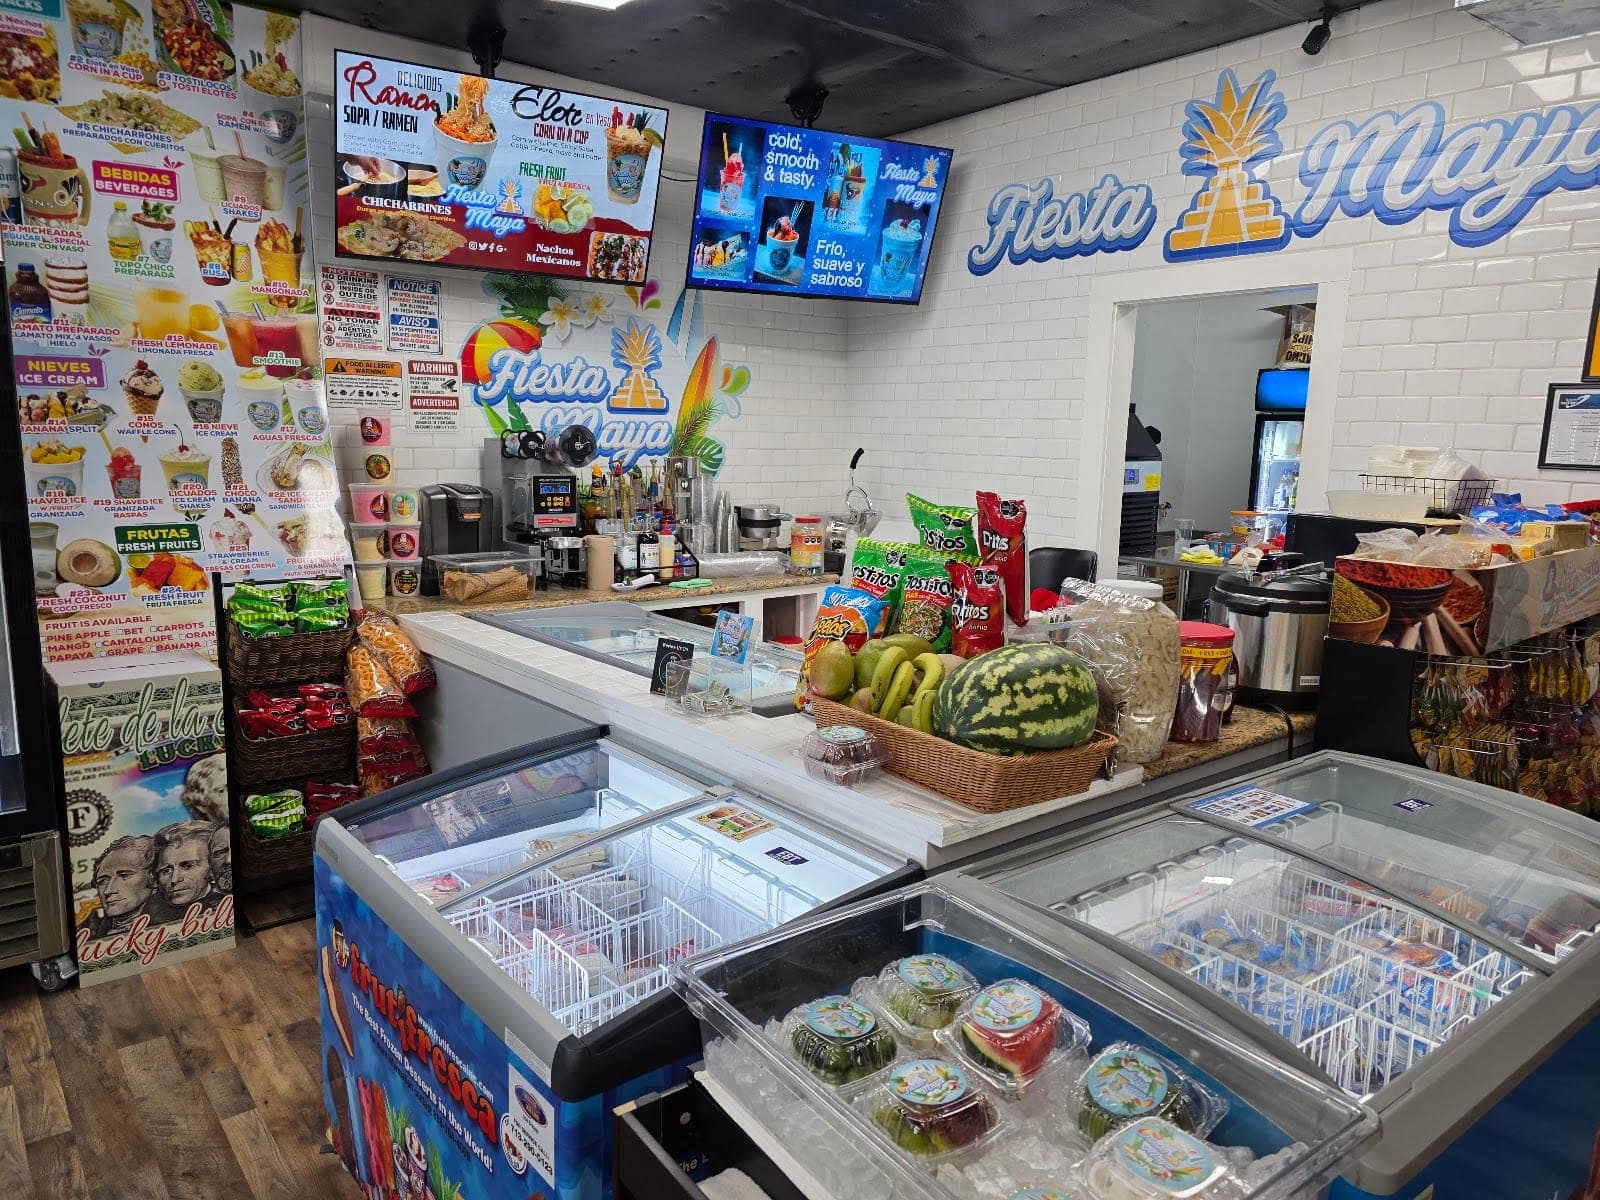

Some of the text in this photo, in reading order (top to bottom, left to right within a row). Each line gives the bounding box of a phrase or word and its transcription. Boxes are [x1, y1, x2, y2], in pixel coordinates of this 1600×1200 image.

[67, 62, 143, 81] CORN IN A CUP
[173, 75, 232, 92] TOSTILOCOS
[397, 70, 443, 93] DELICIOUS
[201, 86, 237, 100] ELOTES
[217, 119, 251, 133] RAMEN
[343, 105, 419, 134] SOPA / RAMEN
[585, 113, 594, 125] en
[596, 114, 612, 128] Vaso
[62, 127, 186, 153] PREPARADOS CON CUERITOS
[92, 124, 172, 143] CHICHARRONES
[533, 122, 590, 145] CORN IN A CUP
[768, 132, 803, 153] cold,
[765, 151, 820, 172] smooth
[101, 166, 171, 186] BEBIDAS
[519, 161, 568, 181] FRESH FRUIT
[764, 165, 815, 189] & tasty.
[881, 163, 920, 182] Fiesta
[95, 179, 176, 199] BEVERAGES
[563, 180, 591, 191] FRESCA
[440, 184, 497, 209] Fiesta
[895, 183, 937, 208] Maya
[221, 201, 260, 212] LICUADOS
[361, 195, 452, 216] CHICHARRINES
[223, 208, 259, 218] SHAKES
[465, 207, 526, 237] Maya
[970, 174, 1157, 275] Fiesta
[18, 226, 83, 239] MICHEADAS
[39, 243, 85, 253] CON VASO
[536, 243, 574, 256] Nachos
[115, 260, 174, 272] TOPO CHICO
[526, 253, 581, 267] Mexicanos
[115, 267, 176, 279] PREPARADA
[202, 269, 228, 278] RUSA
[328, 267, 373, 279] NOTICE
[813, 257, 866, 277] suave y
[337, 275, 379, 285] DRINKING
[393, 280, 434, 293] NOTICE
[810, 273, 863, 288] sabroso
[251, 286, 309, 297] MANGONADA
[339, 291, 378, 300] OUTSIDE
[328, 308, 377, 319] AVISO
[398, 315, 430, 327] AVISO
[56, 325, 121, 336] PREPARADO
[50, 340, 77, 348] HIELO
[131, 339, 219, 350] FRESH LEMONADE
[183, 349, 215, 357] FRESCA
[28, 360, 91, 373] NIEVES
[253, 357, 300, 366] SMOOTHIE
[412, 361, 454, 374] WARNING
[20, 374, 98, 385] ICE CREAM
[475, 349, 608, 403] Fiesta
[412, 397, 457, 408] ADVERTENCIA
[68, 425, 98, 433] SPLIT
[128, 421, 164, 429] CONOS
[211, 423, 239, 431] NIEVE
[252, 434, 324, 442] AGUAS FRESCAS
[168, 489, 217, 497] LICUADOS
[70, 496, 87, 504] ICE
[113, 498, 149, 506] SHAVED
[113, 511, 148, 519] RASPAS
[127, 528, 190, 541] FRUTAS
[118, 540, 199, 552] FRESH FRUITS
[207, 551, 270, 560] STRAWBERRIES
[229, 557, 259, 565] CREAM
[205, 562, 277, 572] FRESAS CON CREMA
[74, 593, 128, 604] COCONUT
[141, 590, 206, 602] FRESH FRUIT
[53, 602, 112, 613] COCO FRESCO
[146, 598, 203, 609] FRUTA FRESCA
[45, 615, 153, 631] FRUIT IS AVAILABLE
[46, 621, 206, 643] PINE APPLE BET CARROTS
[47, 633, 174, 652] MANGO CANTALOUPE
[49, 640, 202, 663] PAPAYA GRAPE BANANA
[121, 676, 207, 754] de la
[71, 804, 92, 830] F
[76, 895, 234, 965] lucky bill
[350, 942, 497, 1144] frutifresca
[352, 992, 494, 1174] The Best Frozen Desserts in the World!
